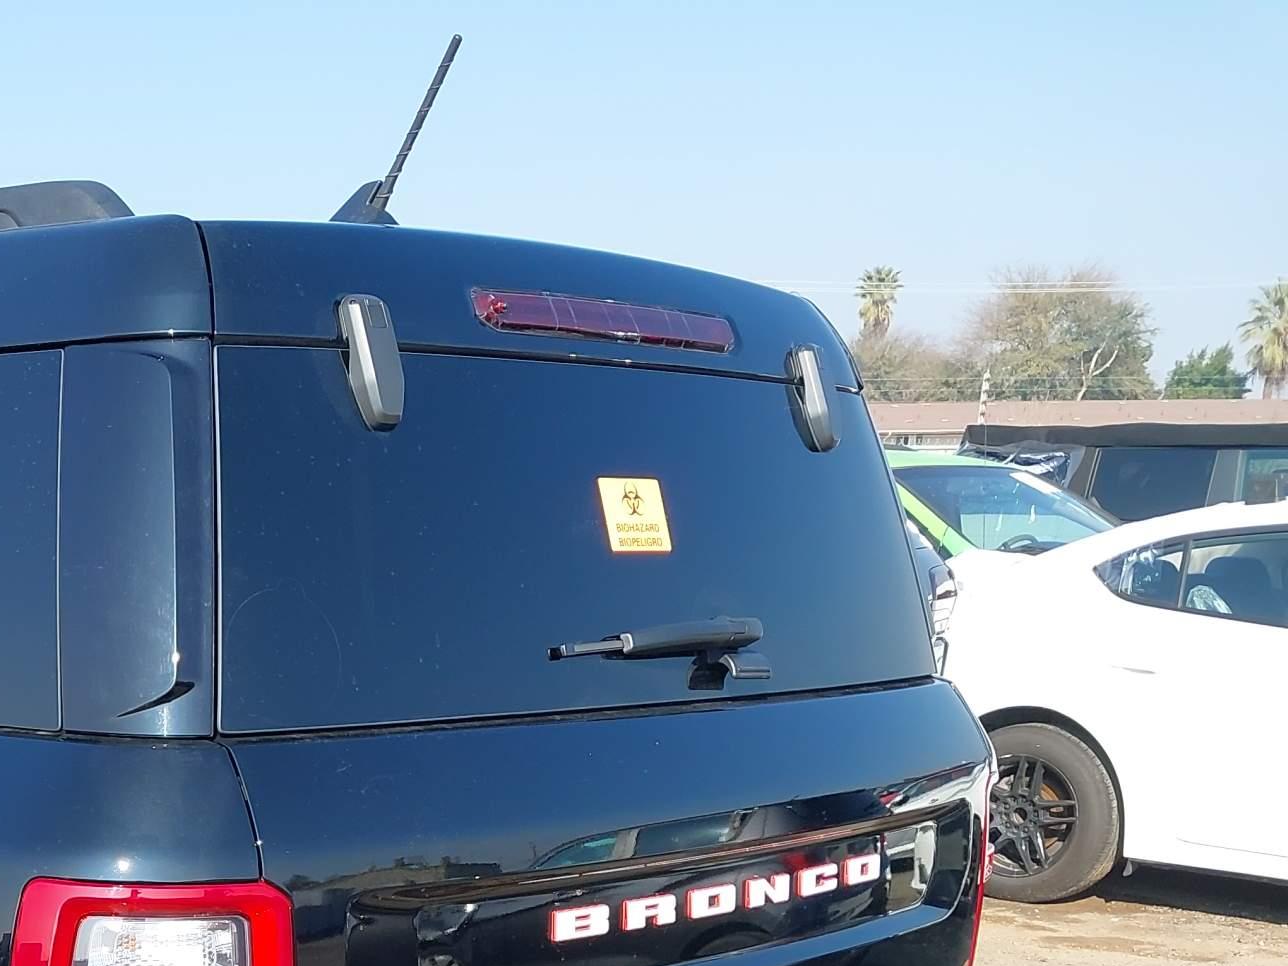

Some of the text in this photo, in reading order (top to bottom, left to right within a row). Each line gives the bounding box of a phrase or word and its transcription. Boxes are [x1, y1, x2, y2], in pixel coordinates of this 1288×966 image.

[616, 523, 660, 532] BIOHAZARD
[618, 537, 663, 547] BIOPELIGRO
[548, 853, 882, 943] BRONCO
